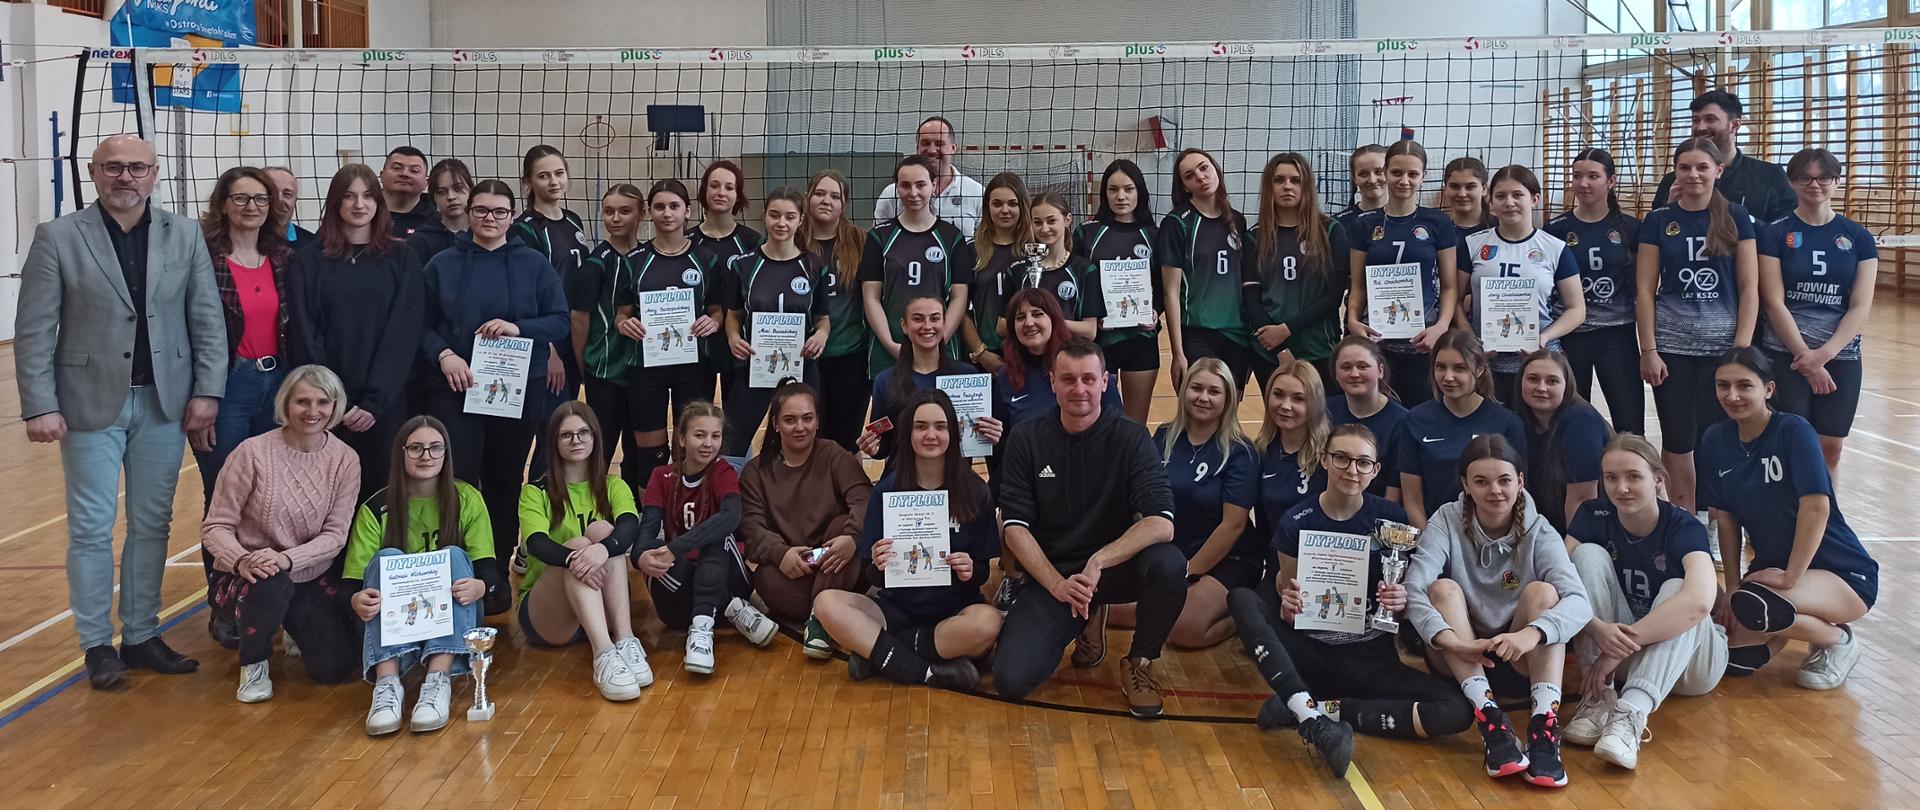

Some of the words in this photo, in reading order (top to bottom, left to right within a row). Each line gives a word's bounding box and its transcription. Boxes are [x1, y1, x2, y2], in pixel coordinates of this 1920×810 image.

[1631, 34, 1660, 48] plus
[1884, 29, 1914, 42] plus
[1126, 43, 1155, 57] plus
[1377, 39, 1407, 53] plus
[91, 48, 132, 59] netex
[213, 51, 237, 62] PLS
[363, 50, 393, 63] plus
[472, 51, 497, 62] PLS
[621, 48, 650, 62] plus
[727, 50, 752, 60] PLS
[875, 47, 903, 60] plus
[1392, 241, 1406, 264] 7
[1686, 236, 1709, 261] 12
[570, 249, 582, 268] 7
[1217, 250, 1228, 275] 6
[1588, 246, 1603, 271] 6
[1812, 250, 1827, 276] 5
[1104, 261, 1147, 271] DYPLOM
[1282, 256, 1296, 281] 8
[1370, 265, 1418, 277] DYPLOM
[1499, 262, 1521, 278] 15
[908, 261, 921, 286] 9
[1485, 279, 1536, 290] DYPLOM
[1796, 281, 1840, 295] POWIAT
[644, 290, 692, 304] DYPLOM
[1786, 290, 1843, 305] OSTROWIECKI
[757, 314, 802, 325] DYPLOM
[479, 337, 530, 351] DYPLOM
[941, 376, 989, 389] DYPLOM
[1193, 461, 1209, 482] 9
[1761, 455, 1784, 483] 10
[1297, 469, 1310, 495] 3
[888, 493, 945, 508] DYPLOM
[683, 502, 696, 530] 6
[1304, 533, 1367, 551] DYPLOM
[386, 552, 447, 571] DYPLOM
[1622, 568, 1650, 599] 13
